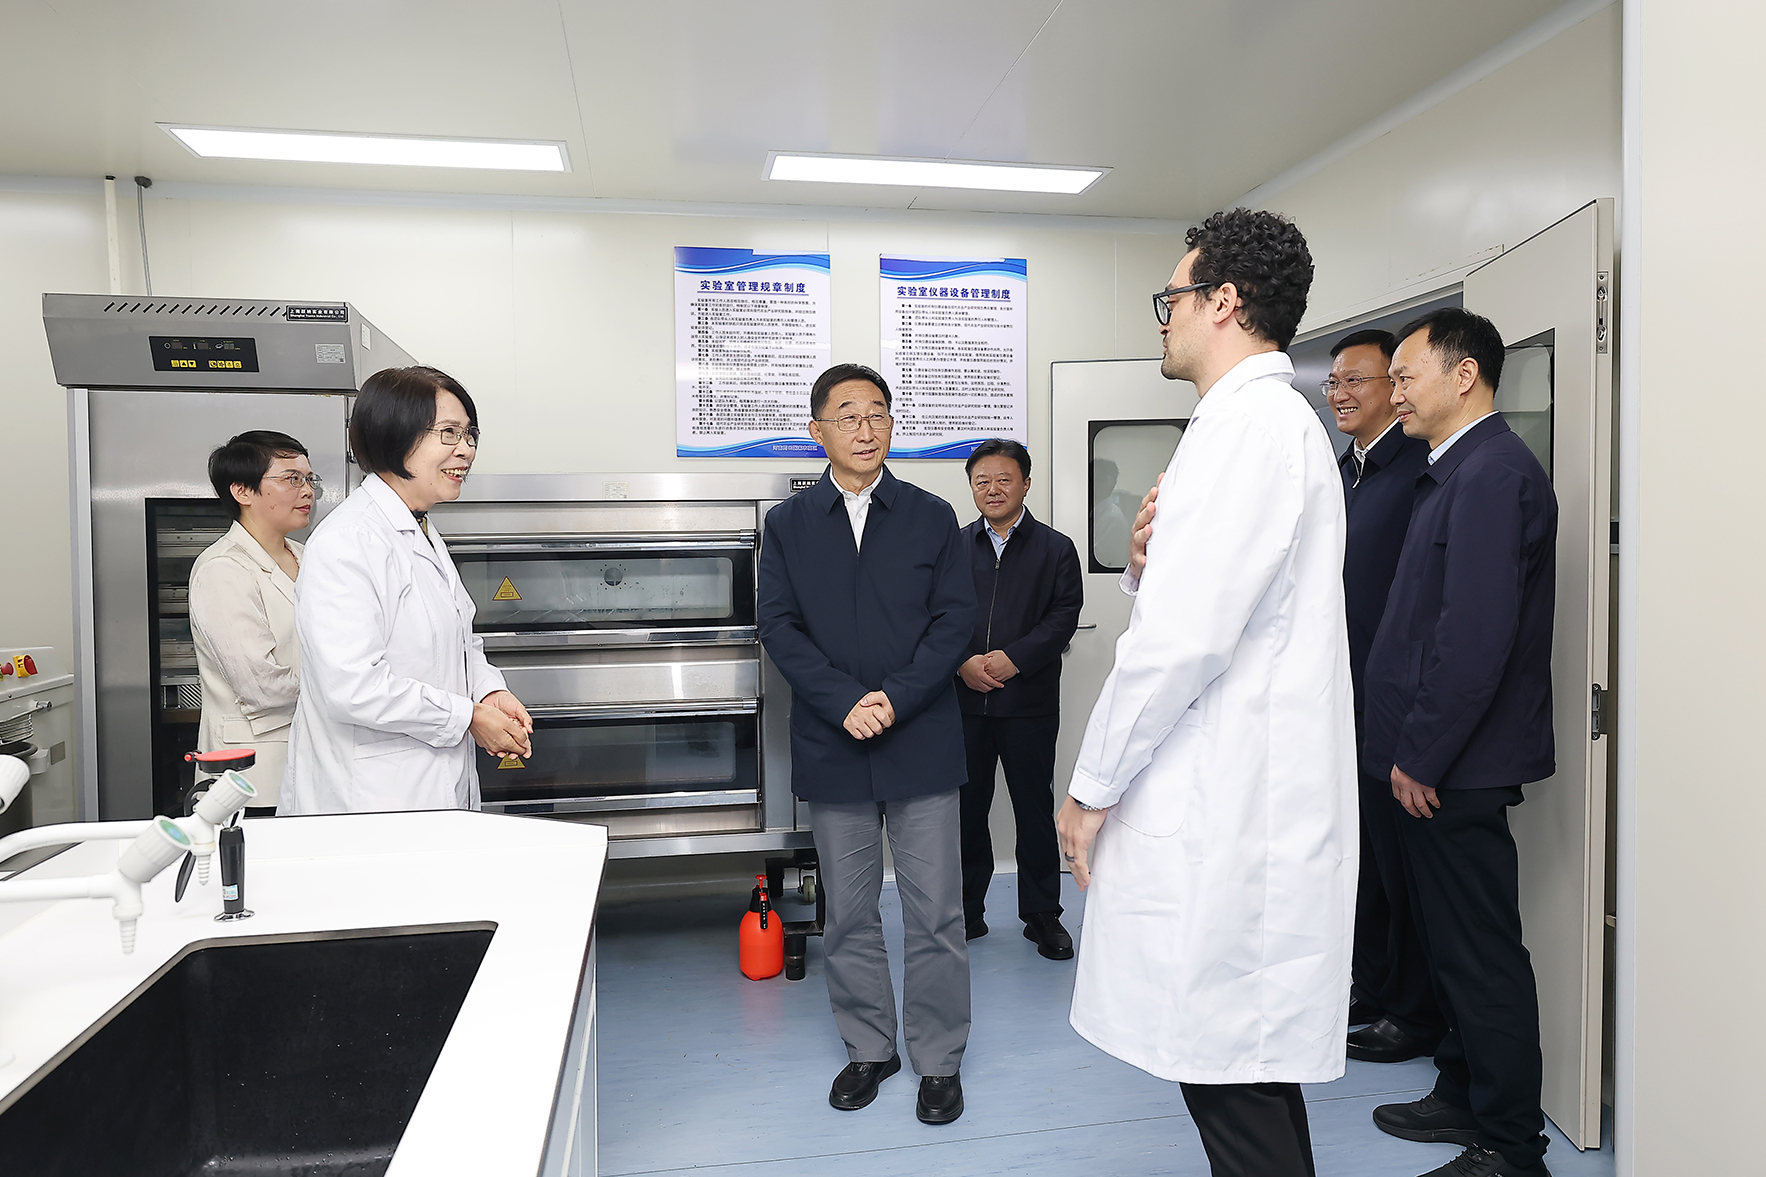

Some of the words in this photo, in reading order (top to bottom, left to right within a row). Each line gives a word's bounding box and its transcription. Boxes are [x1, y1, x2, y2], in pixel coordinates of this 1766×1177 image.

[700, 280, 806, 293] 实验室管理规章制度
[897, 286, 1011, 300] 实验室仪器设备管理制度
